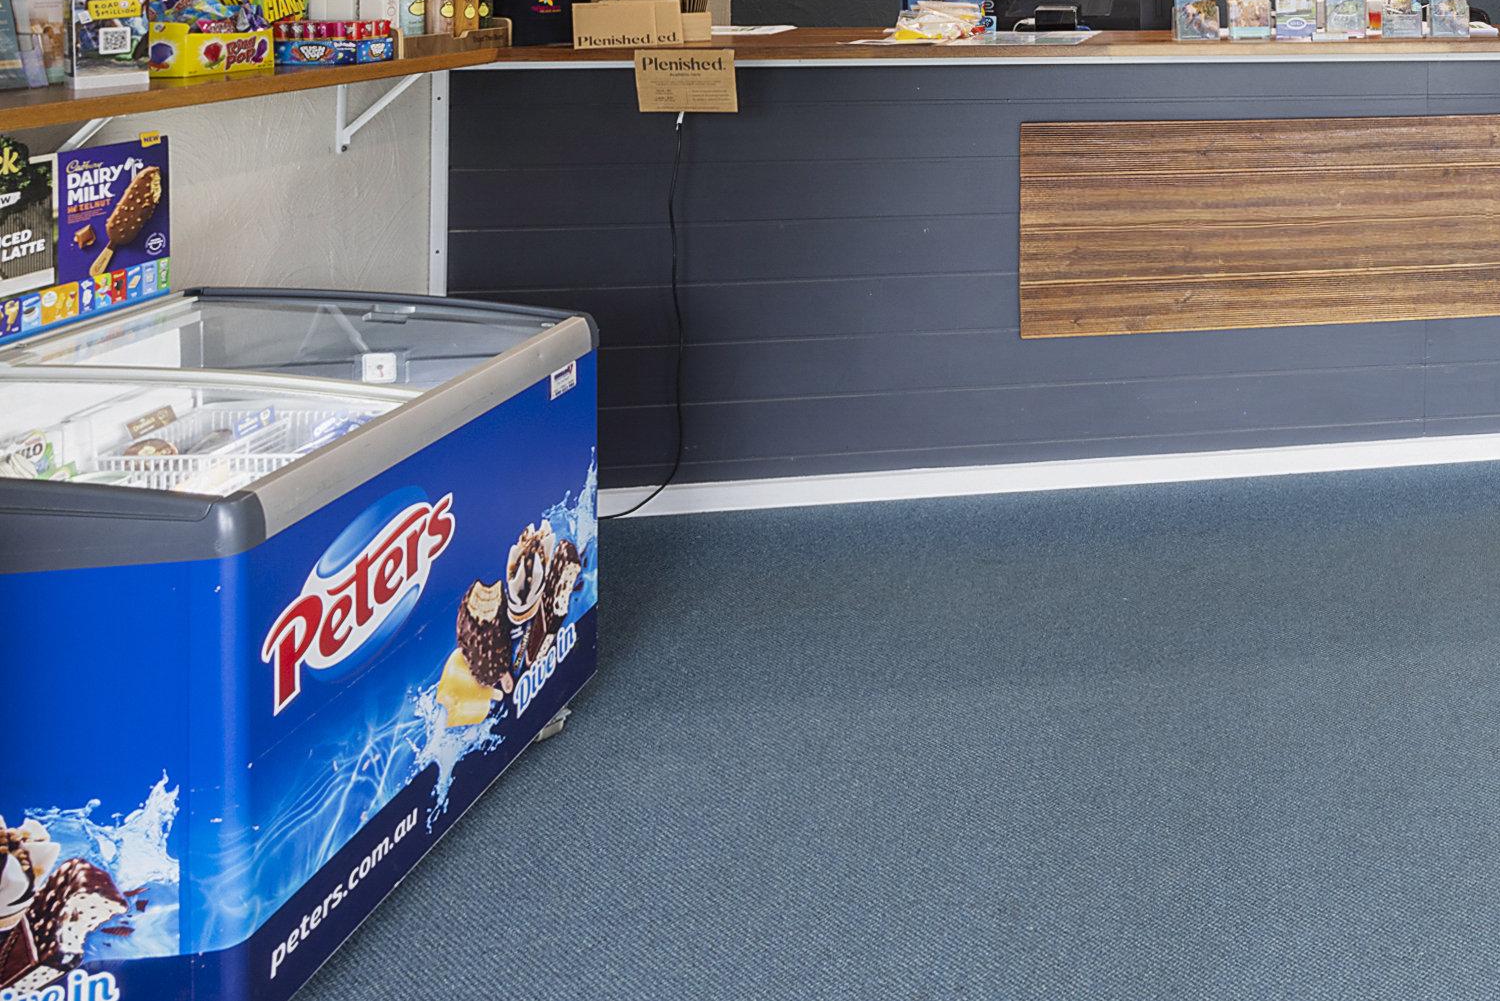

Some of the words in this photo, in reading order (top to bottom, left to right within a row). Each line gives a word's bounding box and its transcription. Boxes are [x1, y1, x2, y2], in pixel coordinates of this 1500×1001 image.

[226, 36, 256, 55] RING
[578, 34, 654, 47] Plenished.
[642, 57, 726, 71] Plenished.
[142, 134, 160, 143] NEW
[67, 164, 125, 189] DAIRY
[67, 182, 116, 206] MILK
[0, 229, 32, 249] CED
[2, 239, 46, 262] LATTE
[262, 492, 455, 716] Peters
[513, 646, 556, 719] Dive
[556, 622, 576, 664] in
[270, 807, 418, 978] peters.com.au
